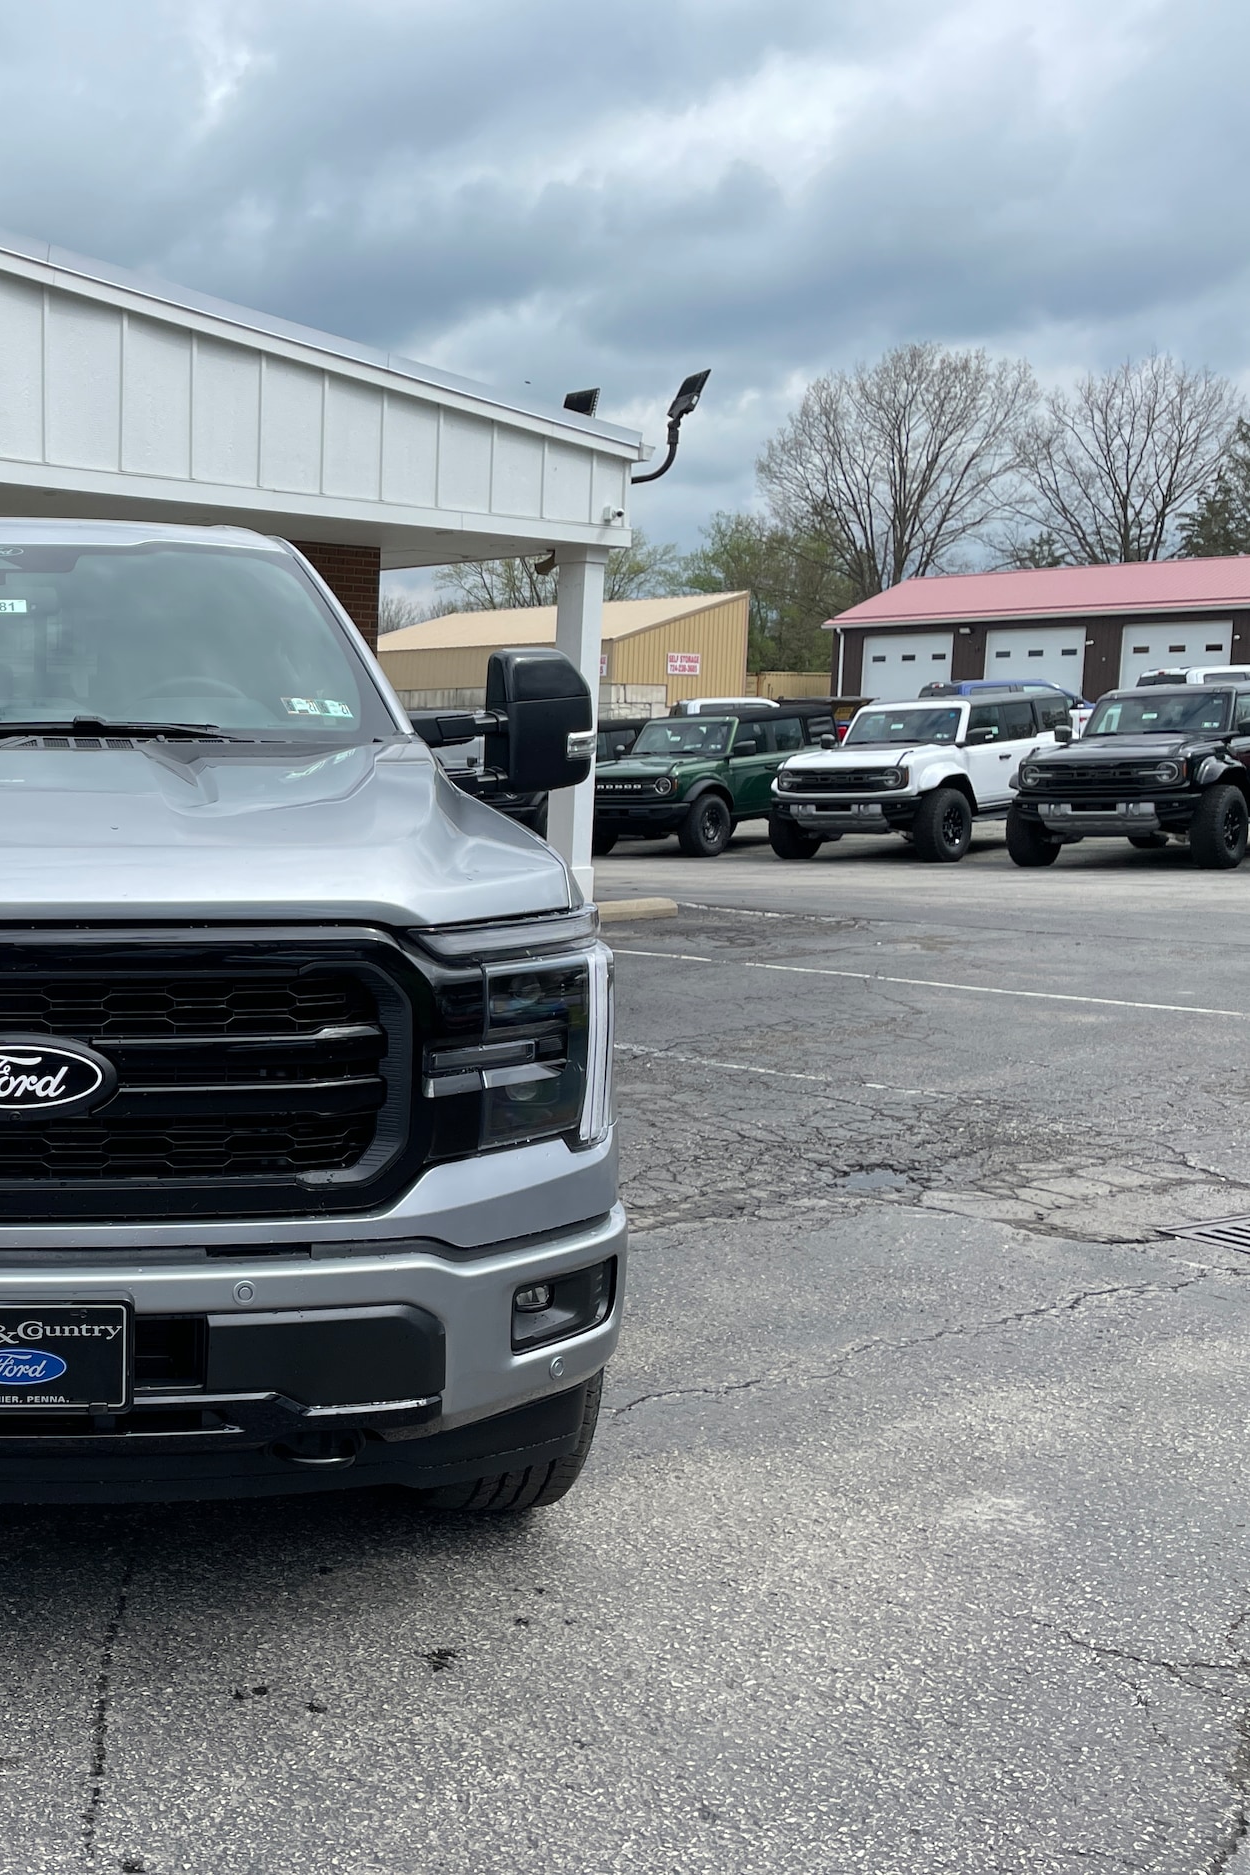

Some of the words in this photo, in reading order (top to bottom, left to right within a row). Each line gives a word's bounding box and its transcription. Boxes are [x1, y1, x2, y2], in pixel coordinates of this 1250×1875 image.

[669, 654, 679, 663] SELF
[680, 655, 700, 664] STORAGE
[26, 1395, 70, 1404] PENNA.
